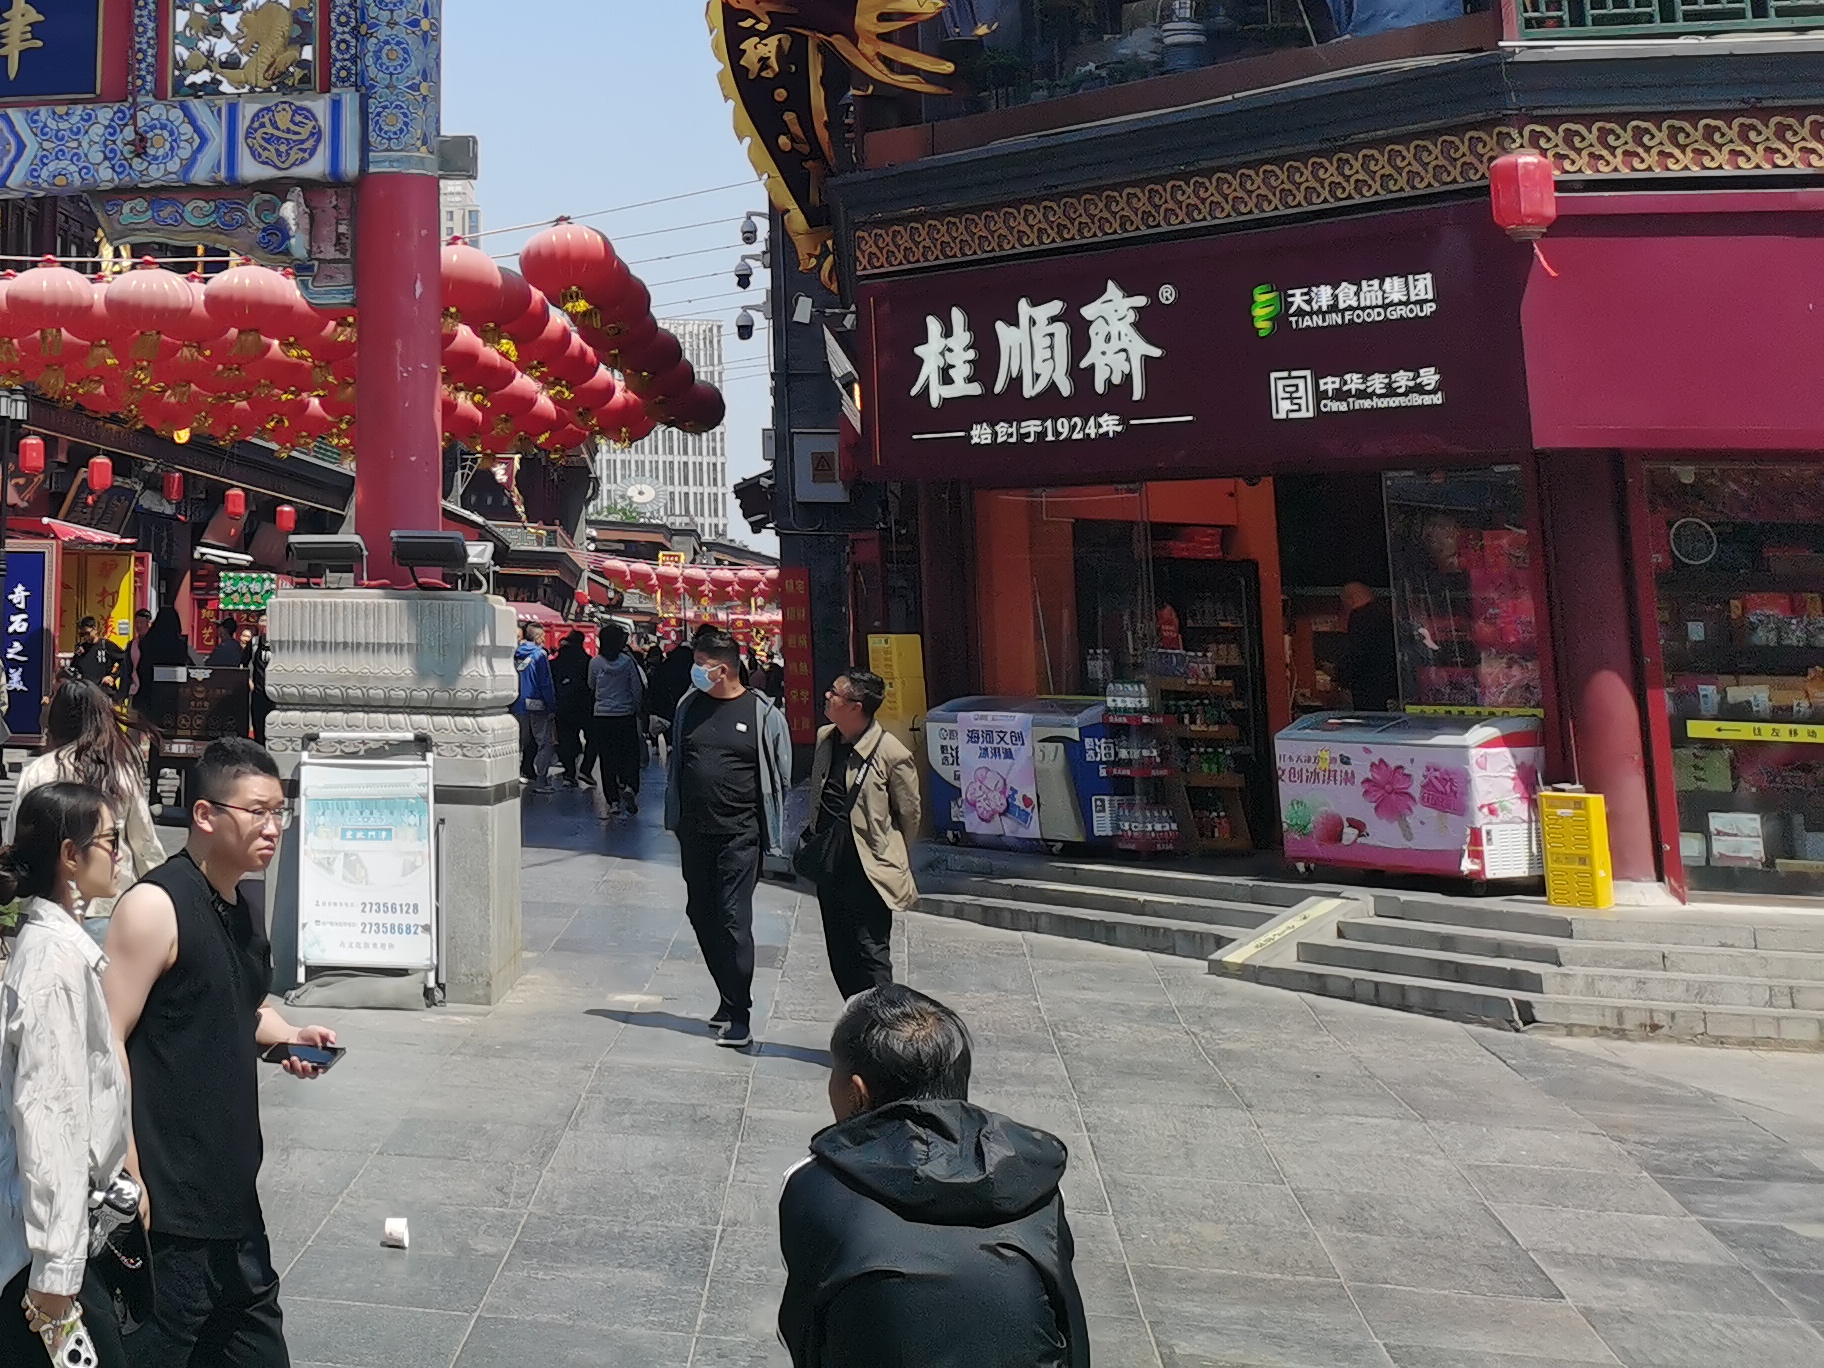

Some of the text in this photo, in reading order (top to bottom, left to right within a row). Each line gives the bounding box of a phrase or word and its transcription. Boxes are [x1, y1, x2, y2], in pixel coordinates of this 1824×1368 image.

[1287, 272, 1434, 314] 天津食品集团
[1288, 302, 1437, 329] TIANJIN FOOD GROUP
[1318, 367, 1442, 397] 中华老字号
[970, 413, 1124, 445] 始创于1924年
[6, 583, 31, 692] 奇石之美
[966, 729, 1026, 746] 海河文创
[360, 902, 419, 915] 27356128
[360, 922, 419, 935] 27358682
